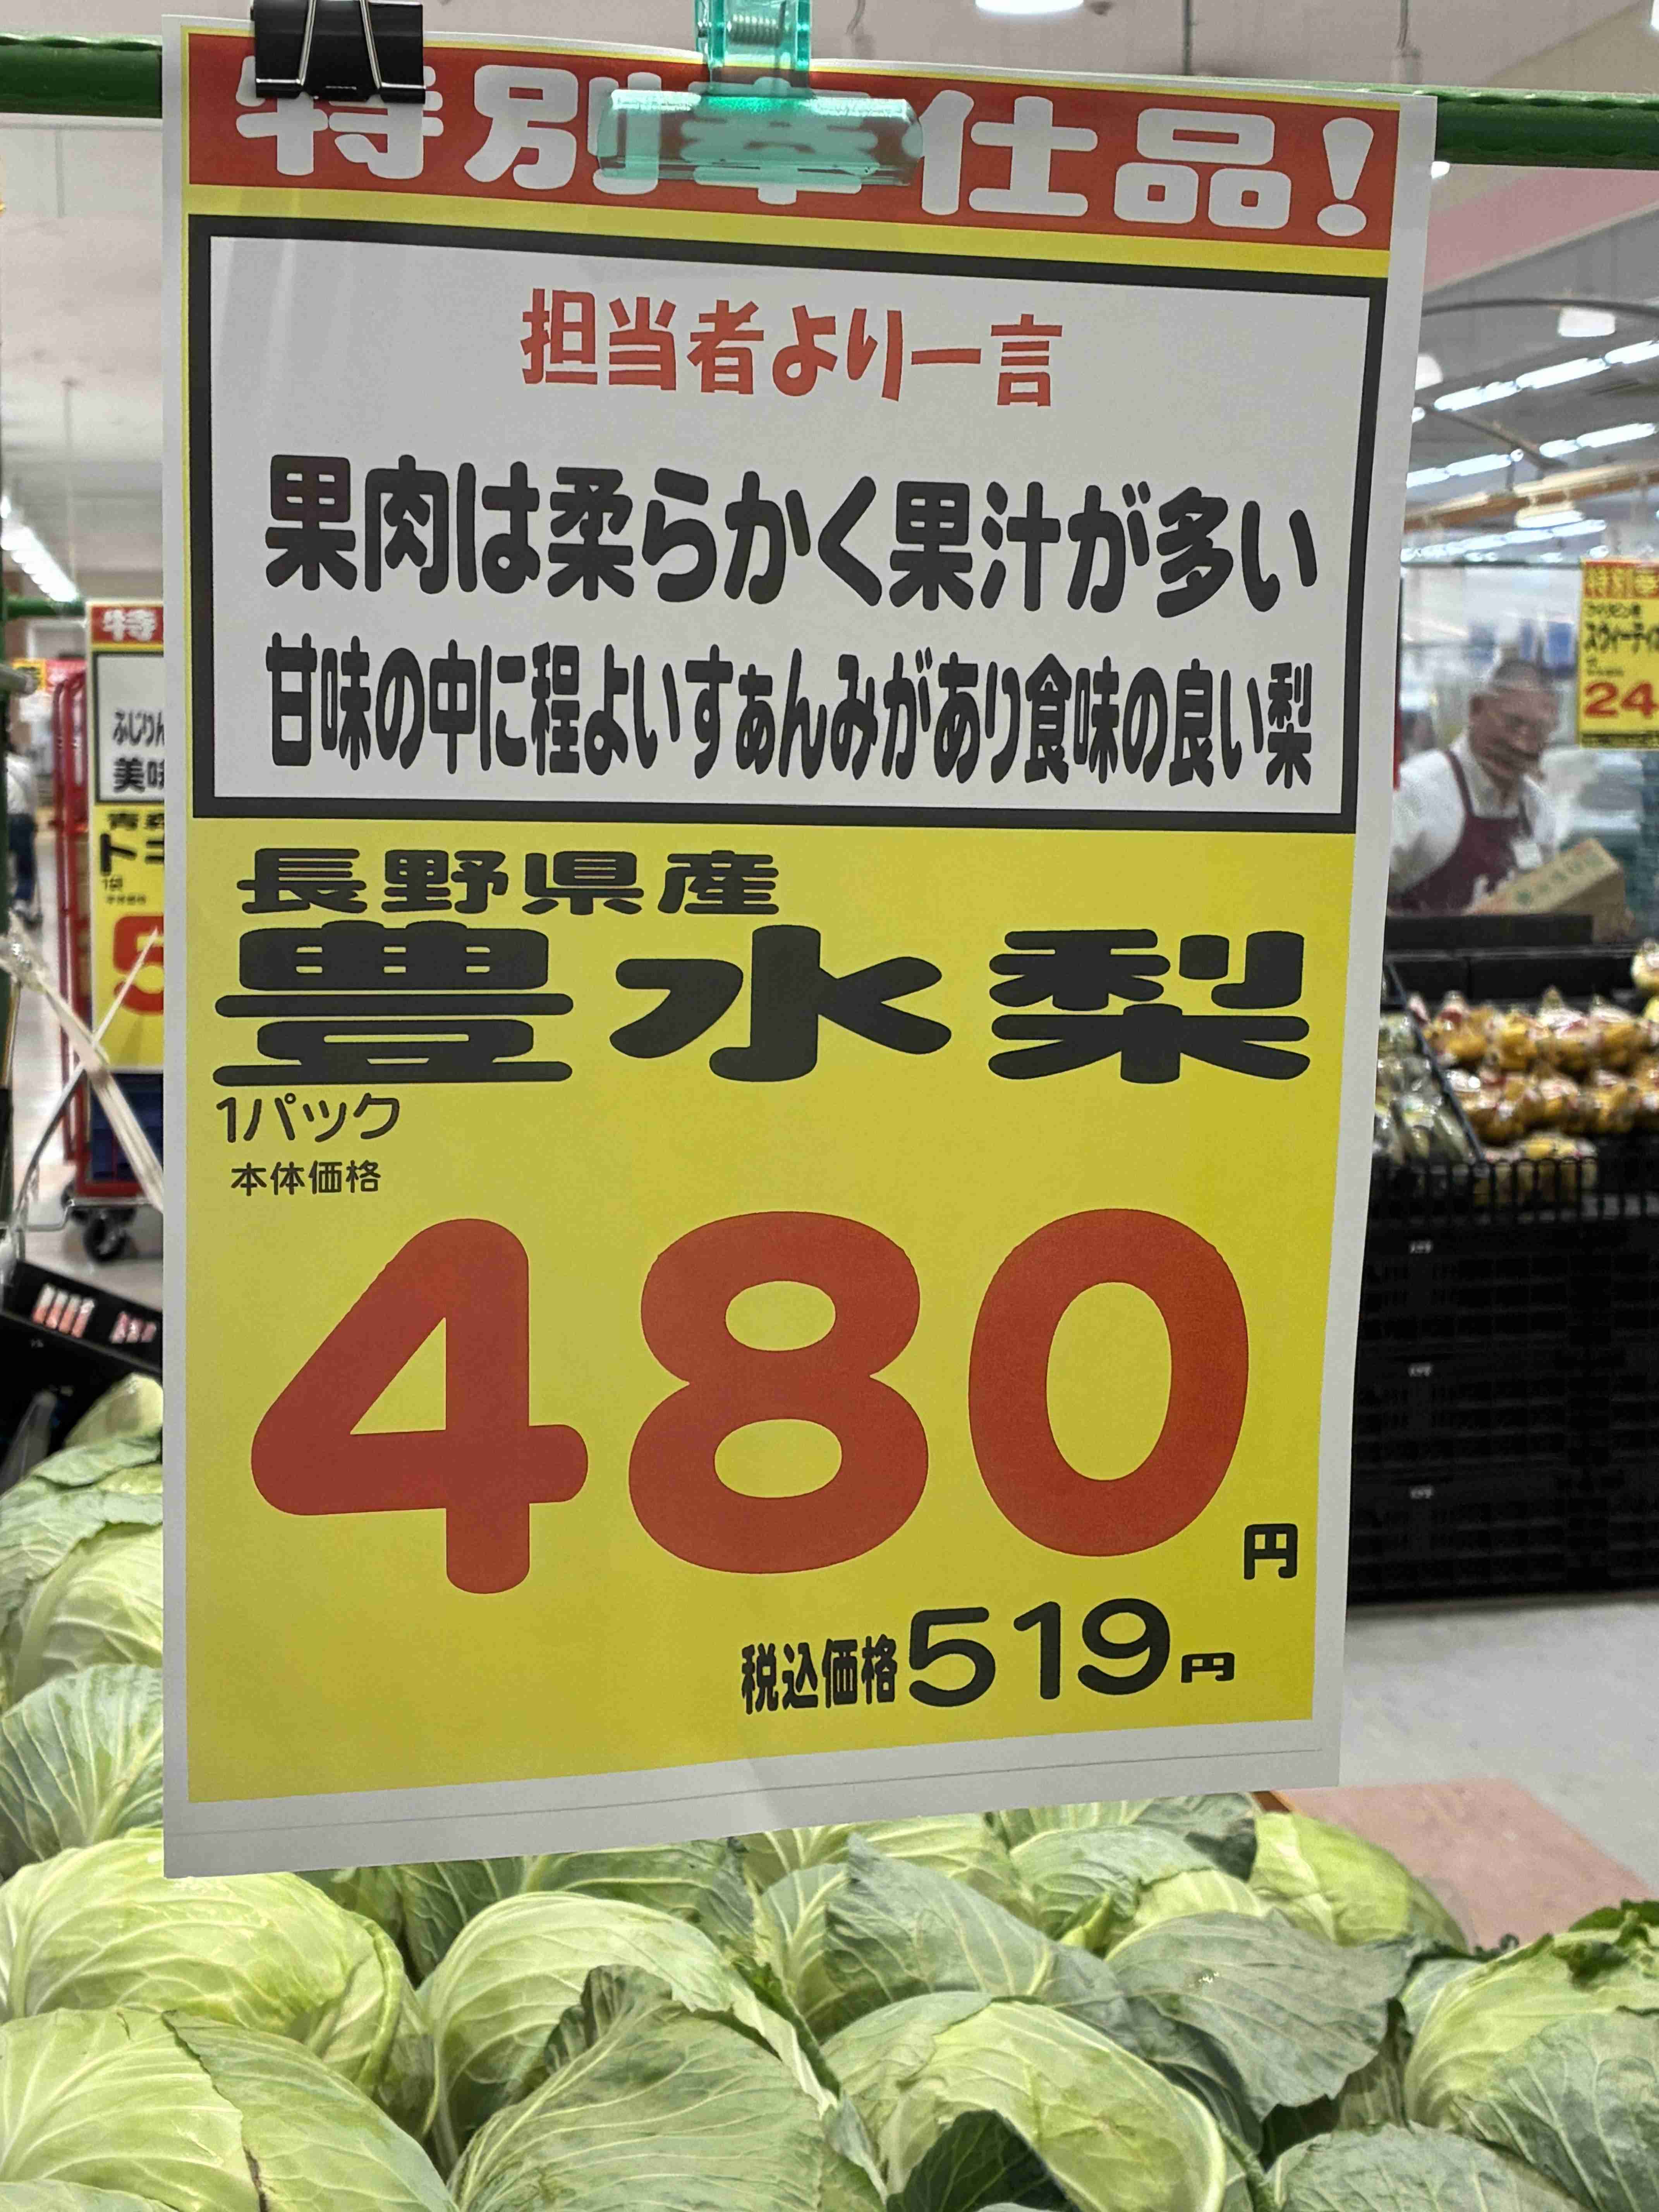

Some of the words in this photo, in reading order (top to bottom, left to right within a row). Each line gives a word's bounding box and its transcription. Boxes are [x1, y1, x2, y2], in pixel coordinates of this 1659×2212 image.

[521, 290, 1062, 406] 担当者より一言
[265, 454, 1317, 618] 果肉は柔らかく果汁が多い
[266, 632, 1312, 789] 甘味の中に程よいすぁんみがあり食味の良い梨
[237, 848, 779, 916] 長野県産
[213, 920, 1310, 1087] 豊水梨
[216, 1092, 400, 1144] 1パック
[231, 1159, 381, 1197] 本体価格
